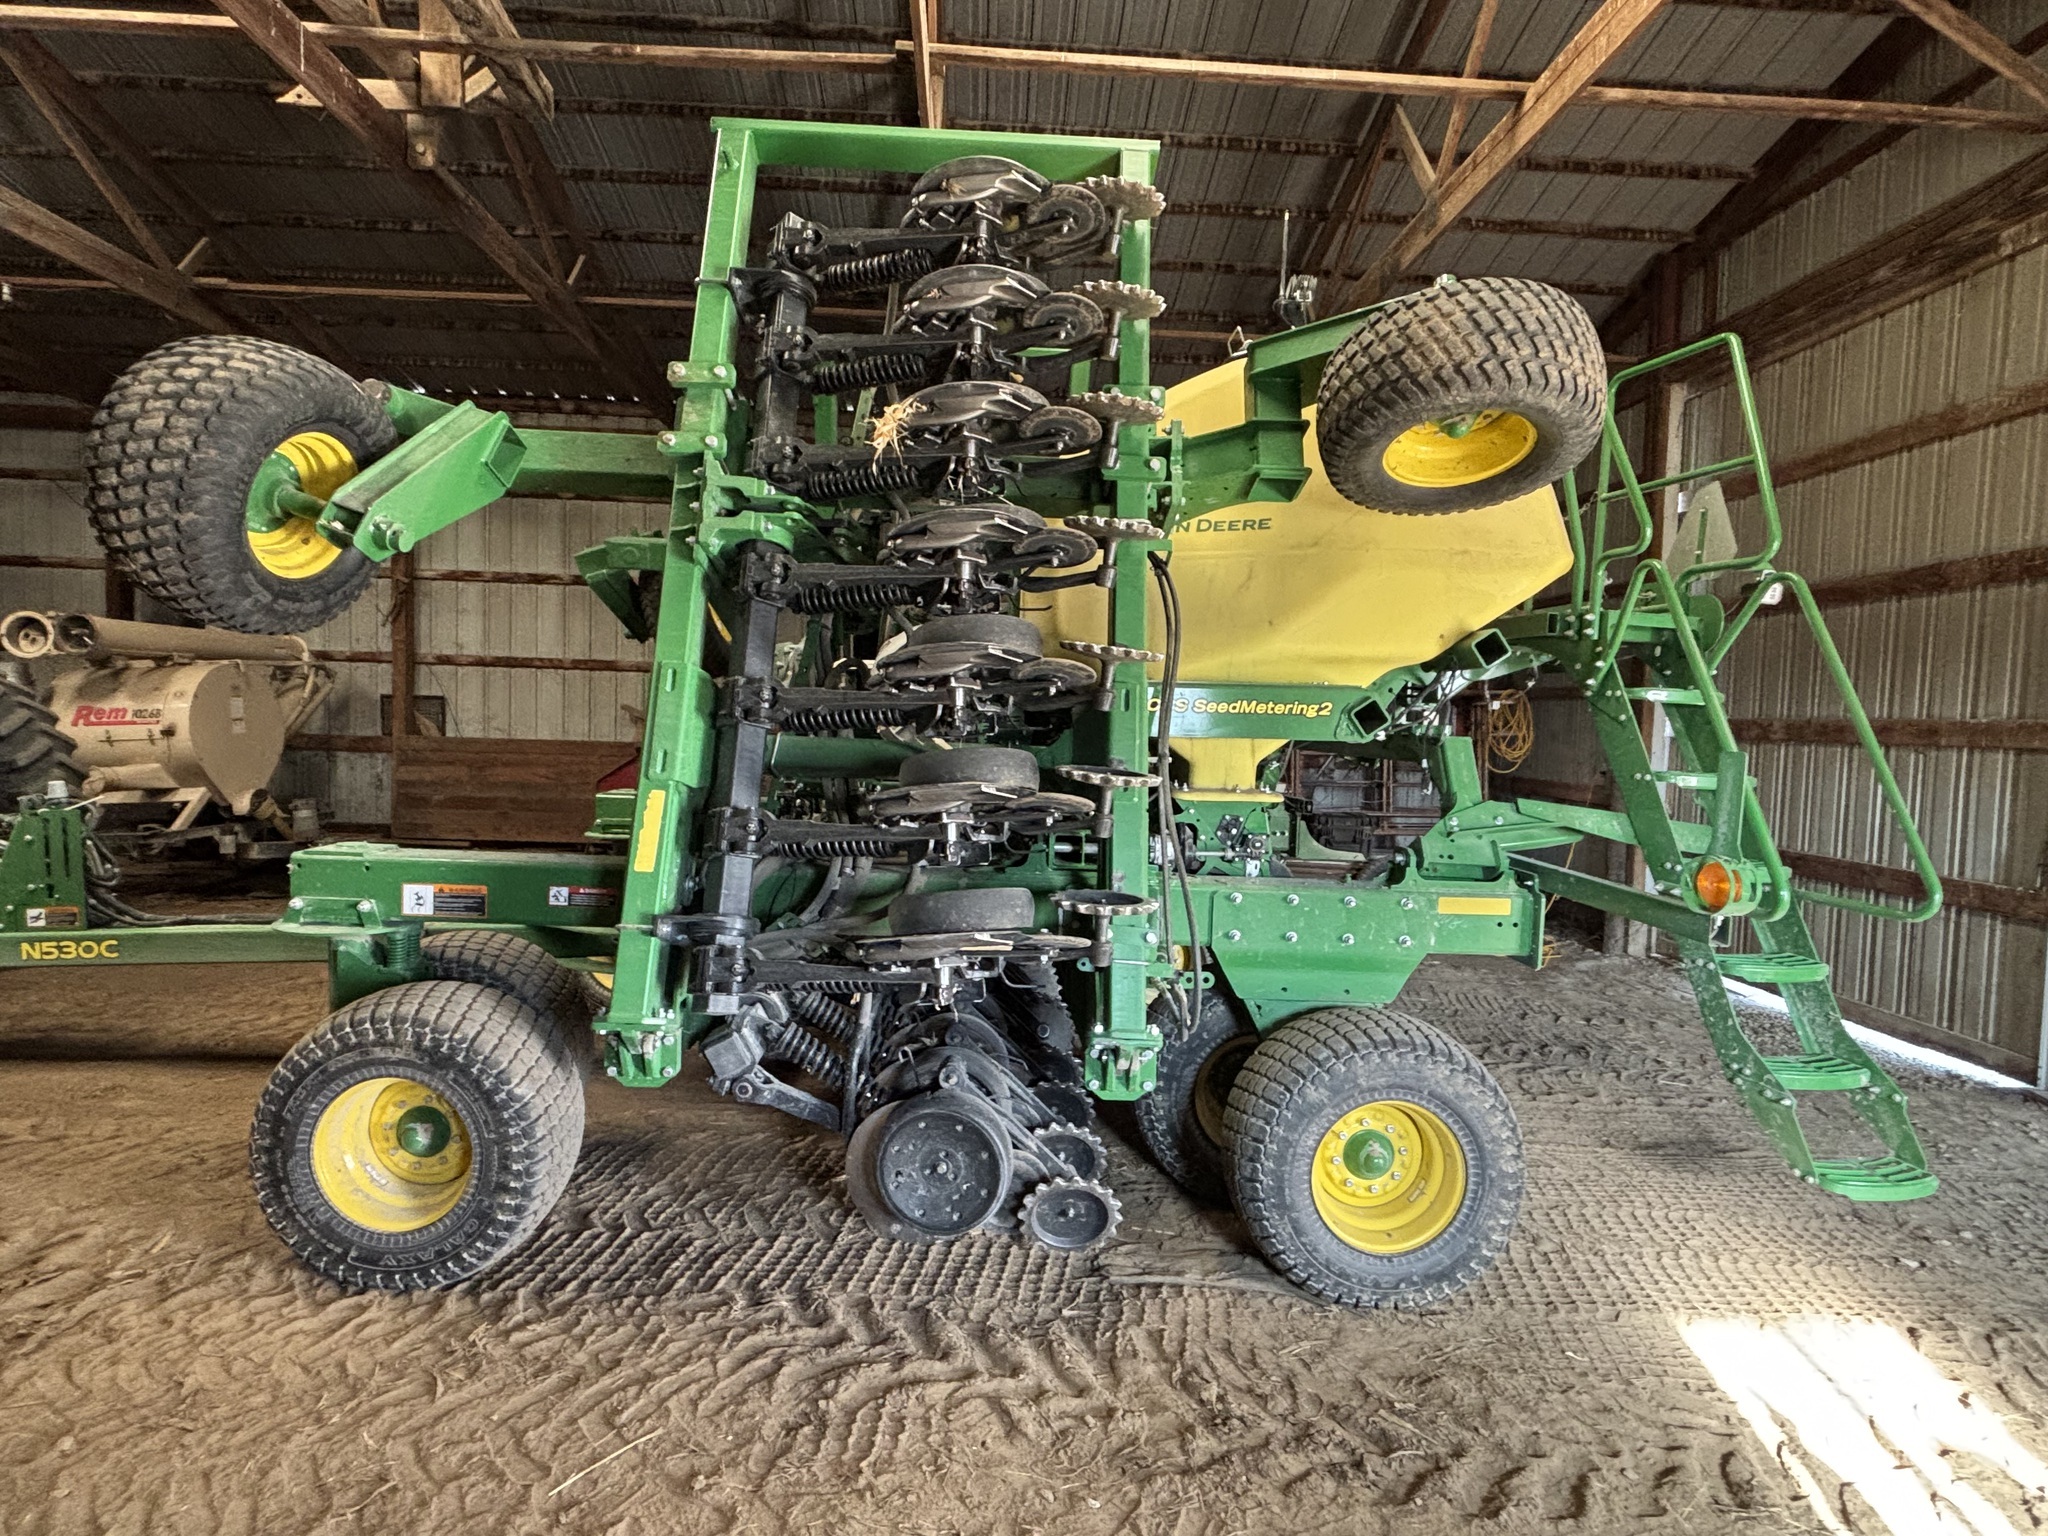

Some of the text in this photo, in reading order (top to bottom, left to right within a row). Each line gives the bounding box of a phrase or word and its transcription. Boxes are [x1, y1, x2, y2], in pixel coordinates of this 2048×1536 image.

[1196, 518, 1272, 532] DEERE
[71, 705, 128, 727] Rem
[1192, 698, 1334, 718] SeedMetering2
[20, 939, 120, 960] N530C
[379, 1218, 479, 1266] GALAXY
